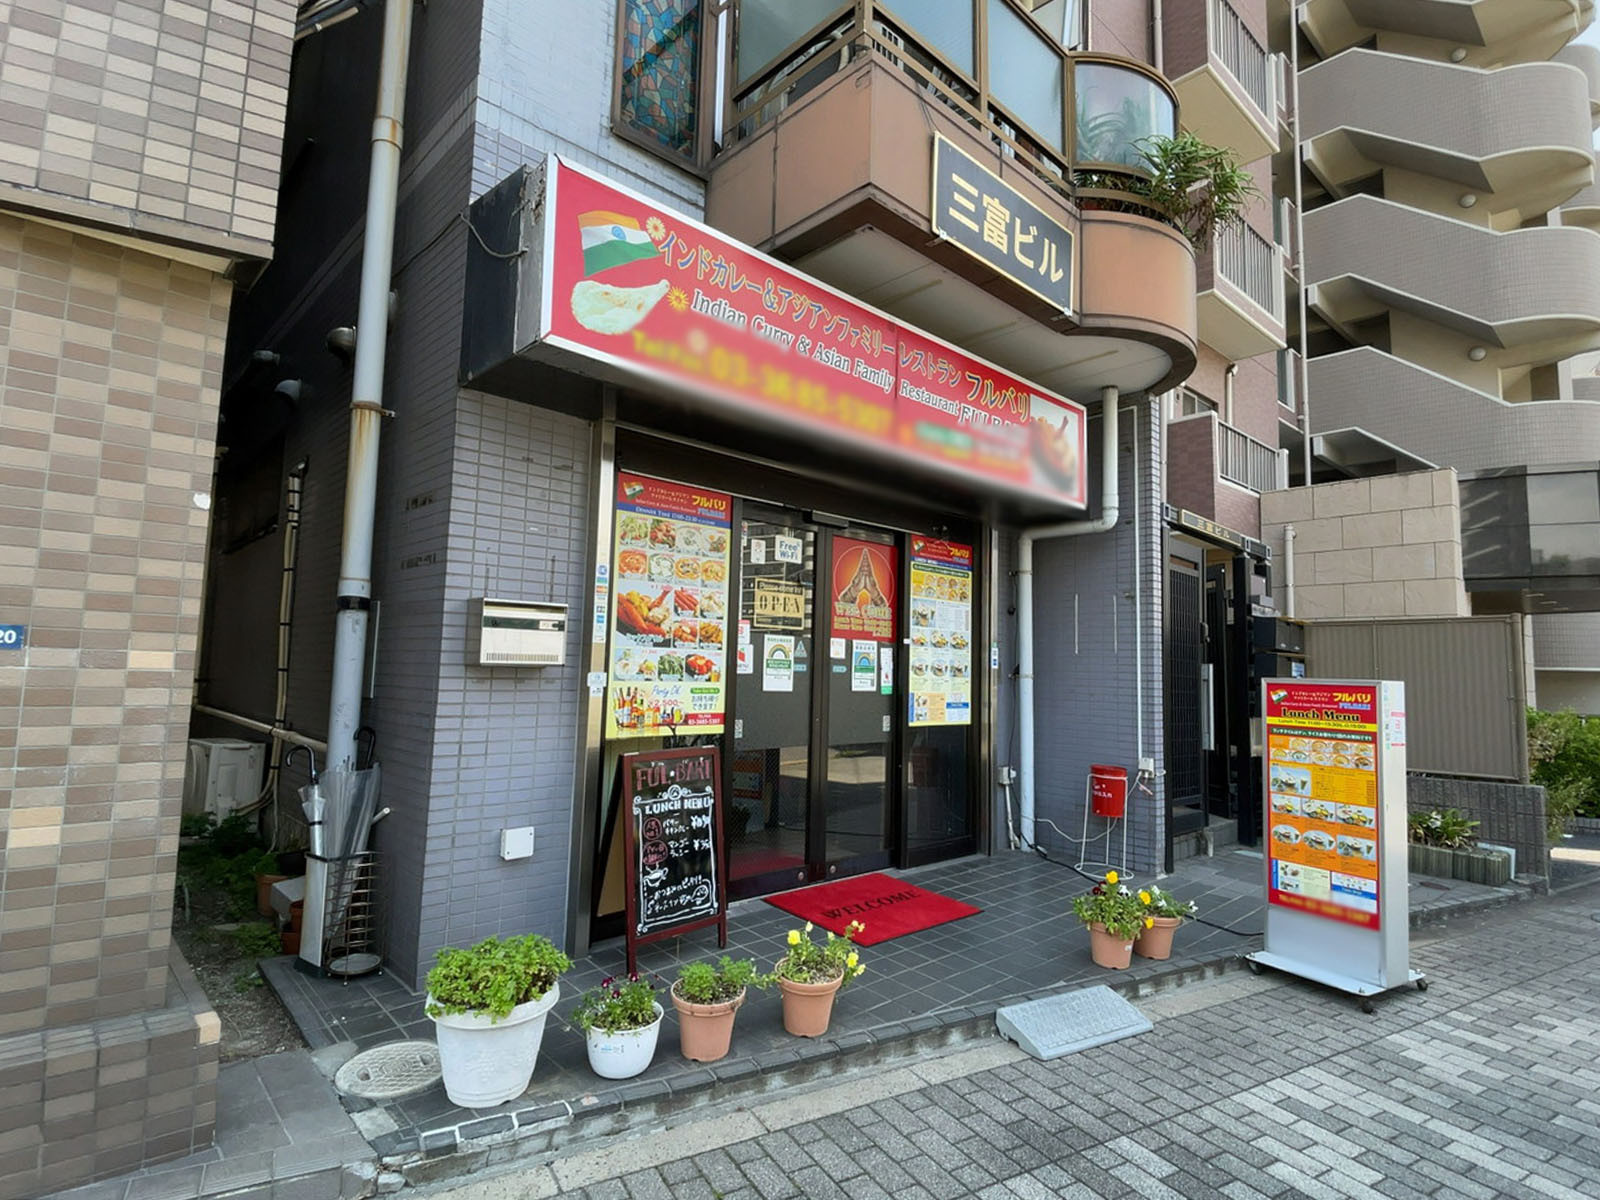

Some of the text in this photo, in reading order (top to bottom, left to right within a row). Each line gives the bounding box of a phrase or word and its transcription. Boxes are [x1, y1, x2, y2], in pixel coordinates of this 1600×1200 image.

[949, 173, 1064, 283] 三富ビル
[692, 288, 748, 328] Indian
[752, 315, 795, 350] Curry
[797, 335, 811, 355] &
[813, 344, 851, 373] Asian
[854, 359, 896, 393] Family
[899, 379, 960, 416] Restaurant
[899, 341, 962, 388] レストラン
[780, 541, 799, 551] Free
[780, 551, 799, 560] Wi-Fi
[1281, 707, 1360, 722] Lunch Menu
[645, 796, 711, 815] LUNCH MENU
[822, 888, 920, 920] WELCOME
